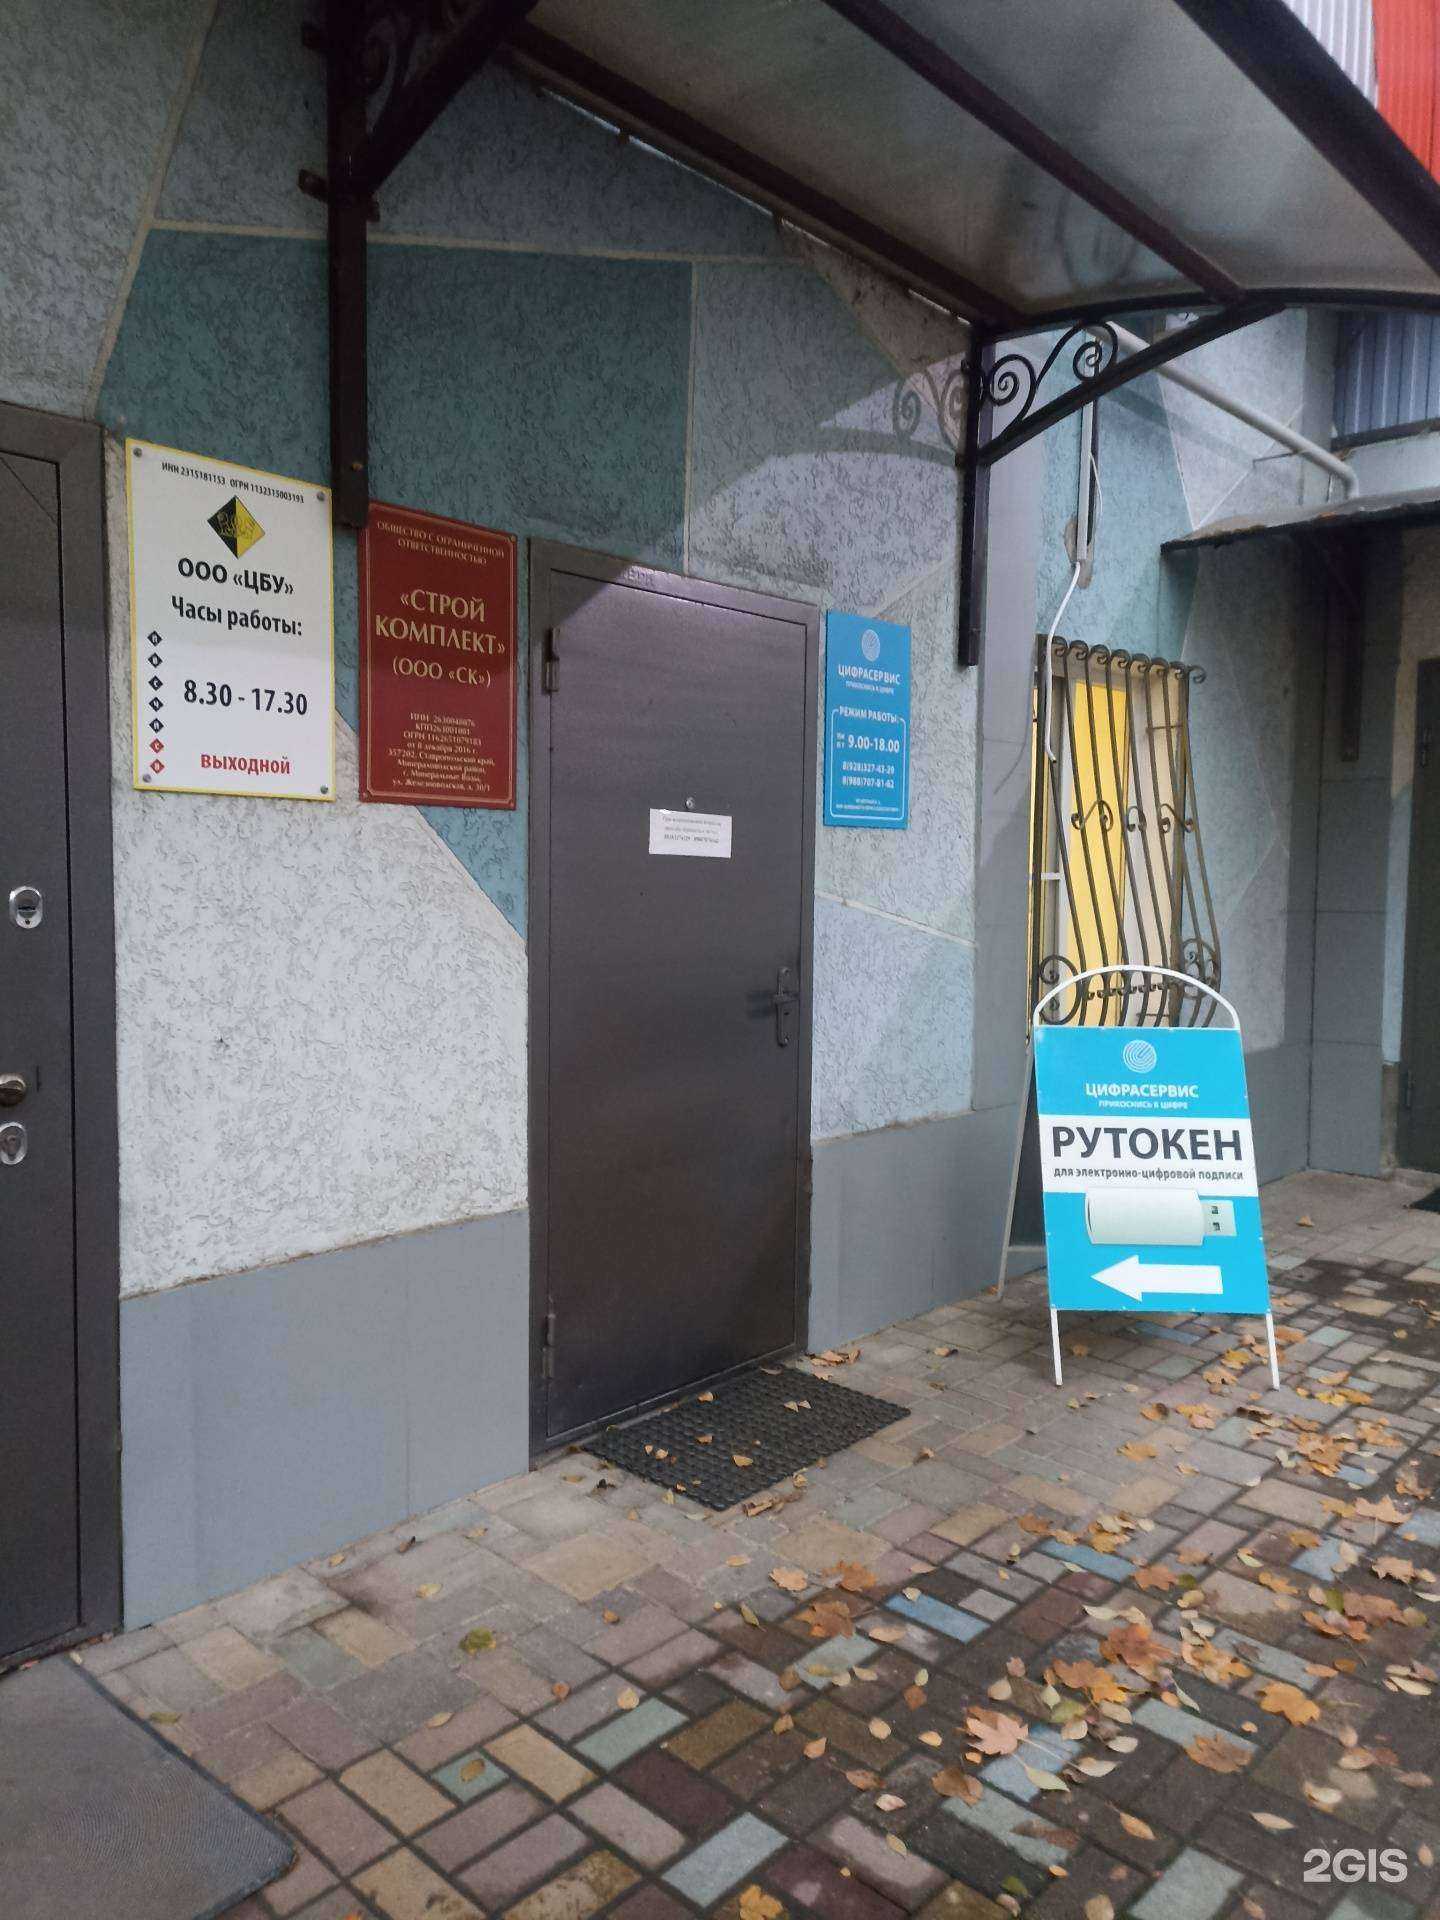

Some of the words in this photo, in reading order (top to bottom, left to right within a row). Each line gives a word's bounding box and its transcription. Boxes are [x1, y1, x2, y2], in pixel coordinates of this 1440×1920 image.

[161, 462, 179, 474] ИНН
[230, 478, 249, 491] ОГРН
[178, 558, 228, 584] ООО
[233, 570, 294, 595] «ЦБУ»
[171, 595, 222, 623] Часы
[227, 609, 302, 636] работы:
[400, 589, 486, 623] «СТРОЙ
[375, 614, 506, 655] КОМПЛЕКТ»
[392, 656, 443, 679] (ООО
[448, 667, 491, 688] «СК»)
[838, 664, 901, 685] ЦИФРАСЕРВИС
[184, 679, 232, 707] 8.30
[251, 688, 308, 715] 17.30
[839, 705, 868, 718] РЕЖИМ
[848, 734, 900, 753] 9.00-18.00
[1085, 1083, 1199, 1098] ЦИФРАСЕРВИС
[1052, 1126, 1243, 1161] РУТОКЕН
[1053, 1167, 1073, 1178] для
[1075, 1167, 1196, 1181] электронно-цифровой
[1198, 1170, 1244, 1181] подписи
